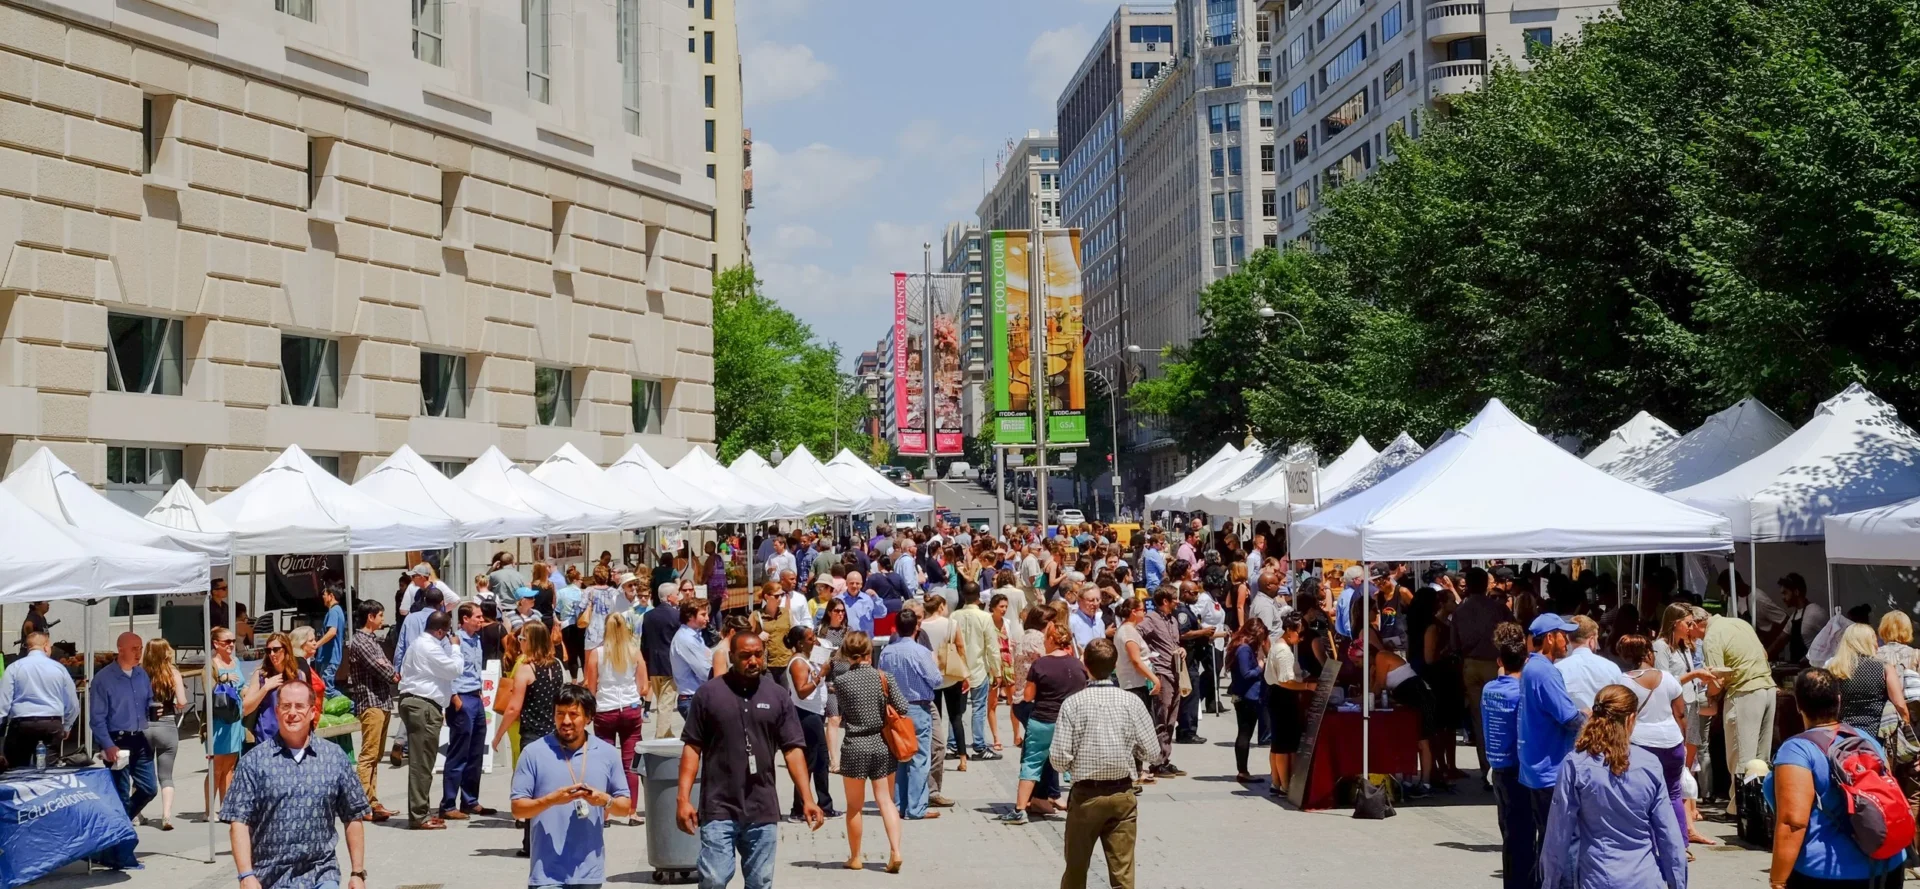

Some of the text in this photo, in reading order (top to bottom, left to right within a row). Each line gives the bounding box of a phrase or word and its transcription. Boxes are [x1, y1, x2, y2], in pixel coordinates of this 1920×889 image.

[994, 238, 1006, 314] FOOD COURT
[896, 280, 906, 378] MEETINGS & EVENTS
[1059, 421, 1075, 429] GSA
